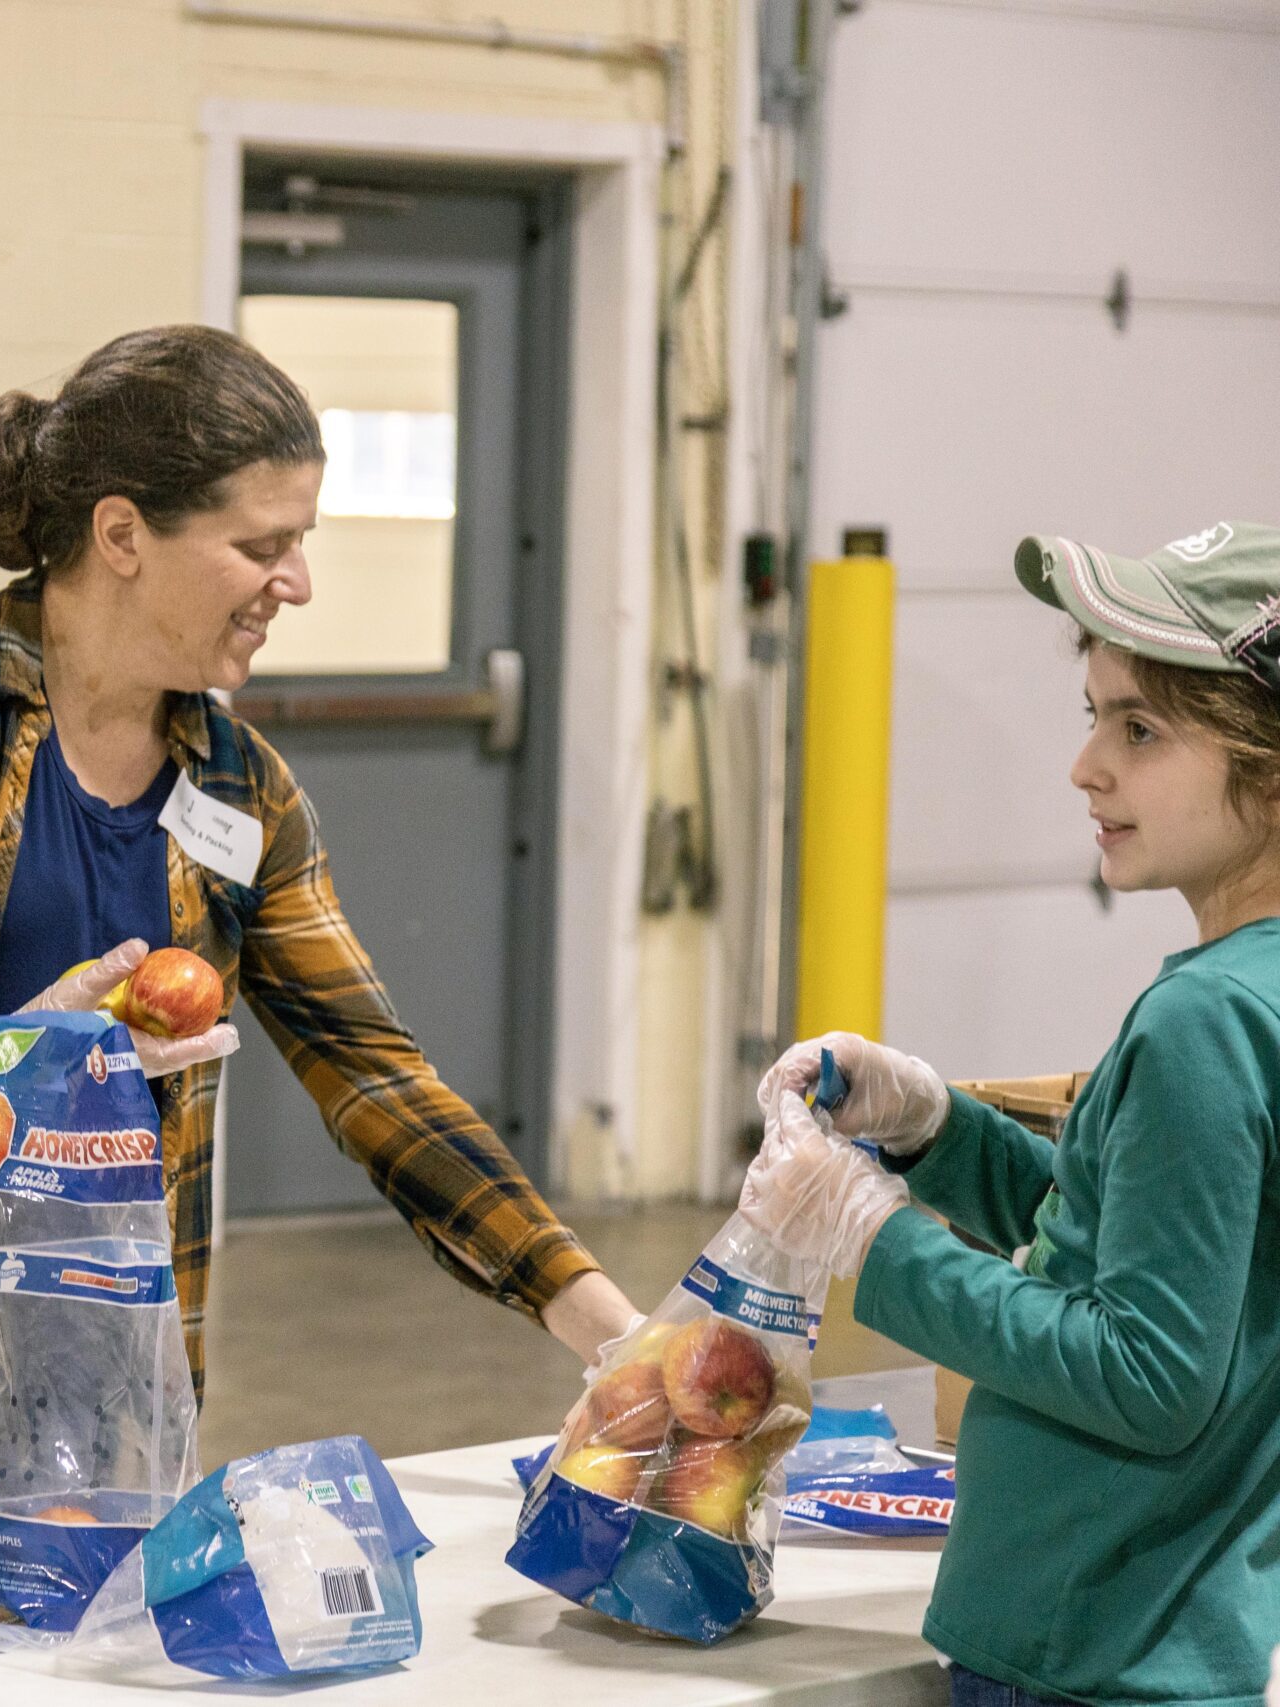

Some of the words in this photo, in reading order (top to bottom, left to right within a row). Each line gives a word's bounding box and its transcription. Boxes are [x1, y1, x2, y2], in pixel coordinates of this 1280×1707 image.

[204, 833, 234, 856] Packing
[22, 1130, 157, 1165] HONEYCRISP
[9, 1174, 65, 1194] POMMES
[13, 1166, 60, 1183] APPLES
